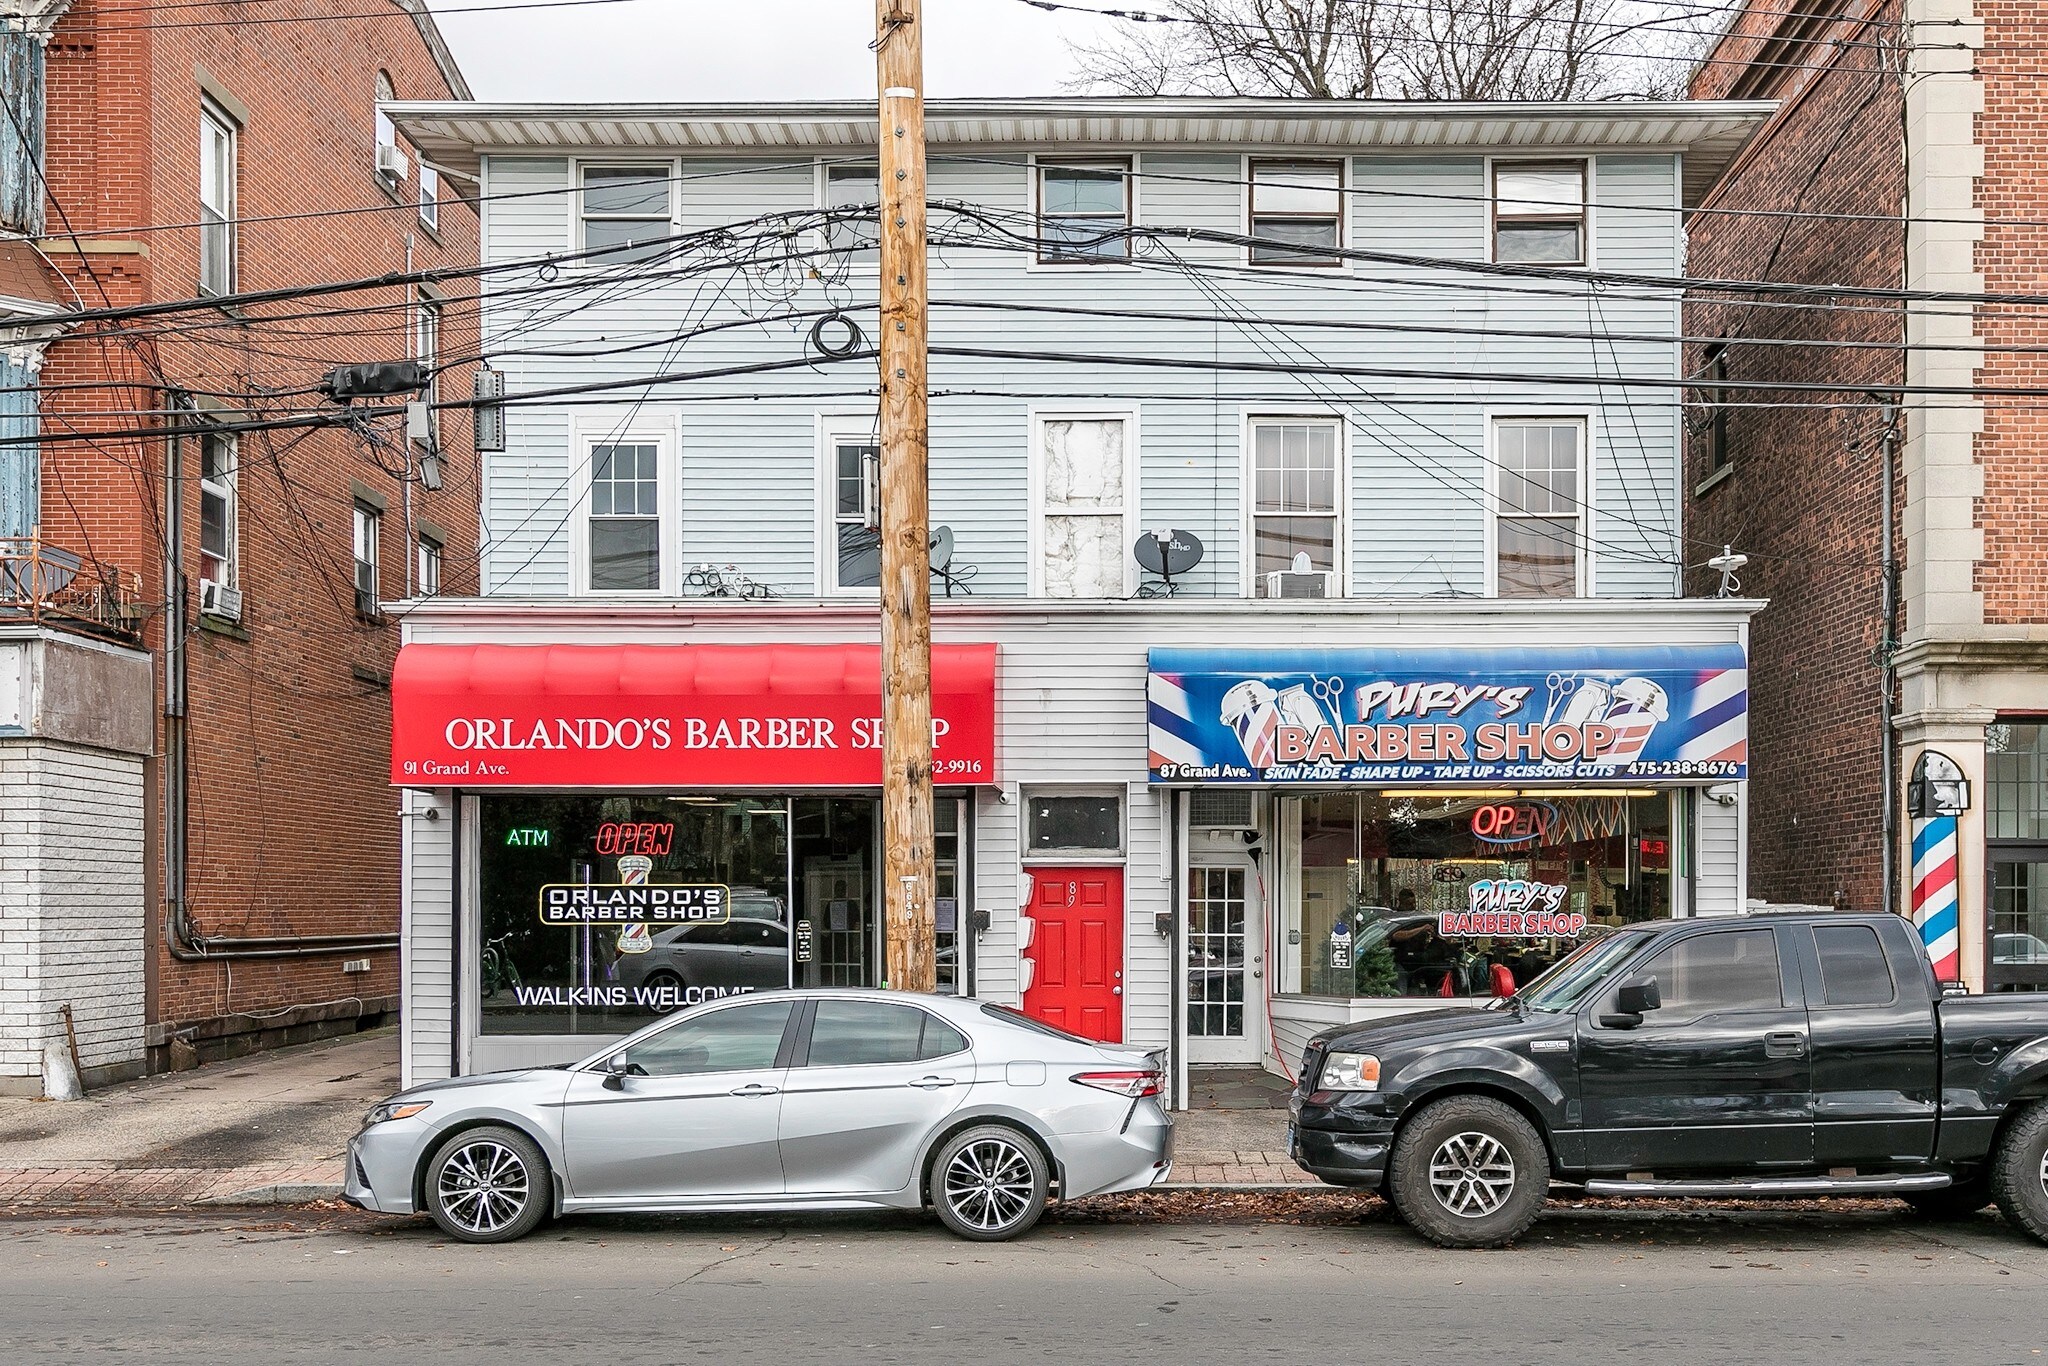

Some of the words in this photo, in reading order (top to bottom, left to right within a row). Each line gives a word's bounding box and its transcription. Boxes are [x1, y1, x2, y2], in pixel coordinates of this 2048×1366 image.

[1358, 681, 1535, 722] PURY'S
[445, 718, 672, 750] ORLANDO'S
[685, 718, 839, 750] BARBER
[1276, 724, 1466, 763] BARBER
[1474, 722, 1617, 763] SHOP
[403, 761, 417, 775] 91
[422, 760, 470, 775] Grand
[475, 761, 510, 775] Ave.
[1160, 765, 1176, 778] 87
[1180, 764, 1217, 778] Grand
[1222, 763, 1251, 777] Ave.
[1264, 767, 1301, 780] SKIN
[1302, 766, 1342, 780] FADE
[1351, 766, 1400, 779] SHAPE
[1402, 766, 1422, 778] UP
[1433, 766, 1471, 778] TAPE
[1473, 766, 1493, 778] UP
[1503, 765, 1574, 777] SCISSORS
[1575, 765, 1616, 776] CUTS
[1474, 805, 1551, 836] OPEN
[507, 829, 548, 846] ATM
[596, 823, 674, 855] OPEN
[550, 889, 720, 905] ORLANDO'S
[1470, 880, 1567, 913] PURY'S
[550, 906, 645, 919] BARBER
[654, 906, 720, 919] SHOP
[1442, 913, 1524, 935] BARBER
[1524, 913, 1586, 935] SHOP
[516, 987, 627, 1006] WALK-INS
